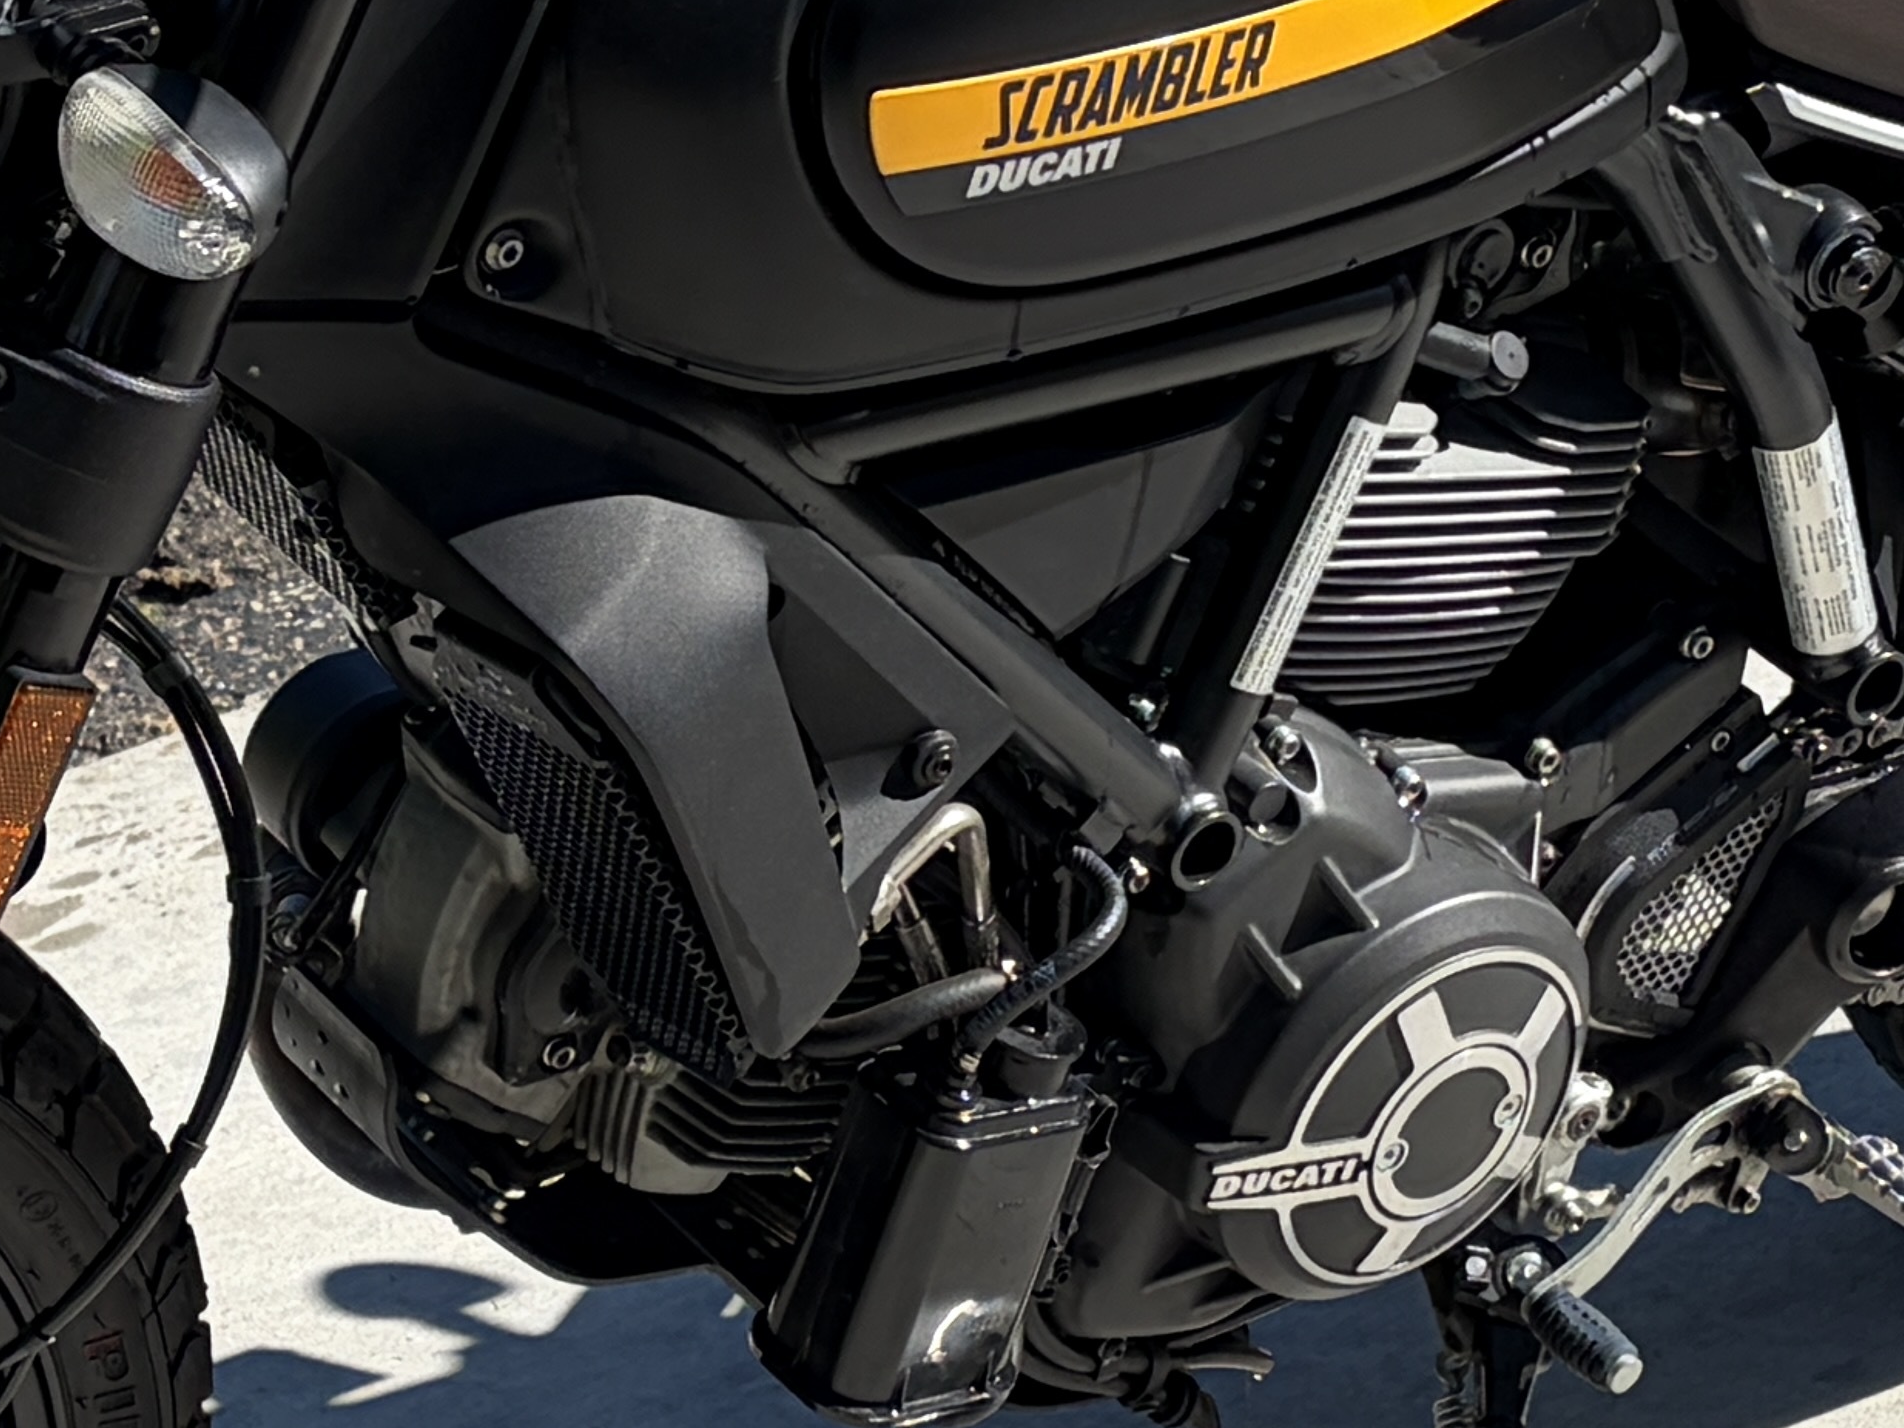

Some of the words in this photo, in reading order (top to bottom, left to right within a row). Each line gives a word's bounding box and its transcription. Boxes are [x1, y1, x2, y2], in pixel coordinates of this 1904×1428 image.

[982, 19, 1276, 150] SCRAMBLER
[966, 136, 1122, 199] DUCATI
[1209, 1157, 1359, 1200] DUCATI
